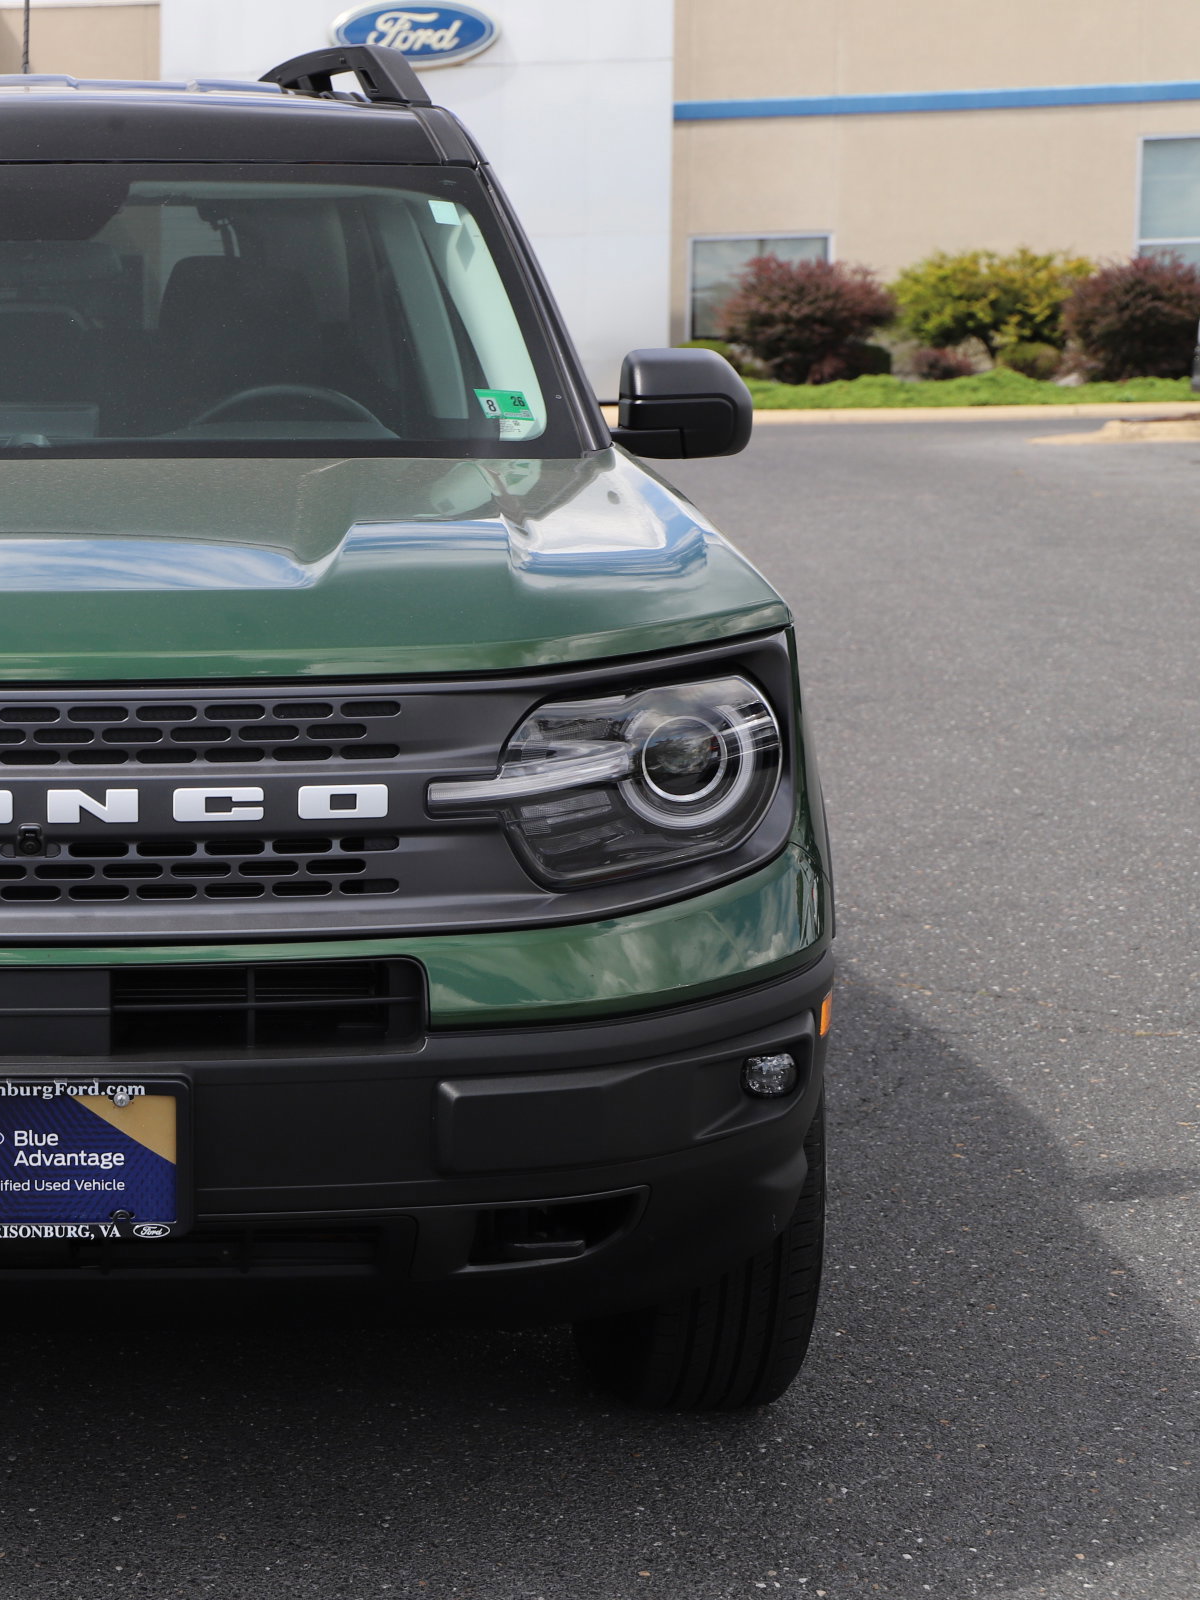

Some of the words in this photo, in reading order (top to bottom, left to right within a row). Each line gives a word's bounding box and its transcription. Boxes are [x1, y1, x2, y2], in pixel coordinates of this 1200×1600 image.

[367, 11, 463, 51] Ford
[486, 399, 496, 411] 8
[510, 396, 525, 406] 26
[13, 1130, 59, 1147] Blue
[13, 1150, 125, 1169] Advantage
[34, 1179, 70, 1192] Used
[74, 1179, 125, 1191] Vehicle
[98, 1225, 121, 1238] VA
[140, 1225, 164, 1236] Ford
